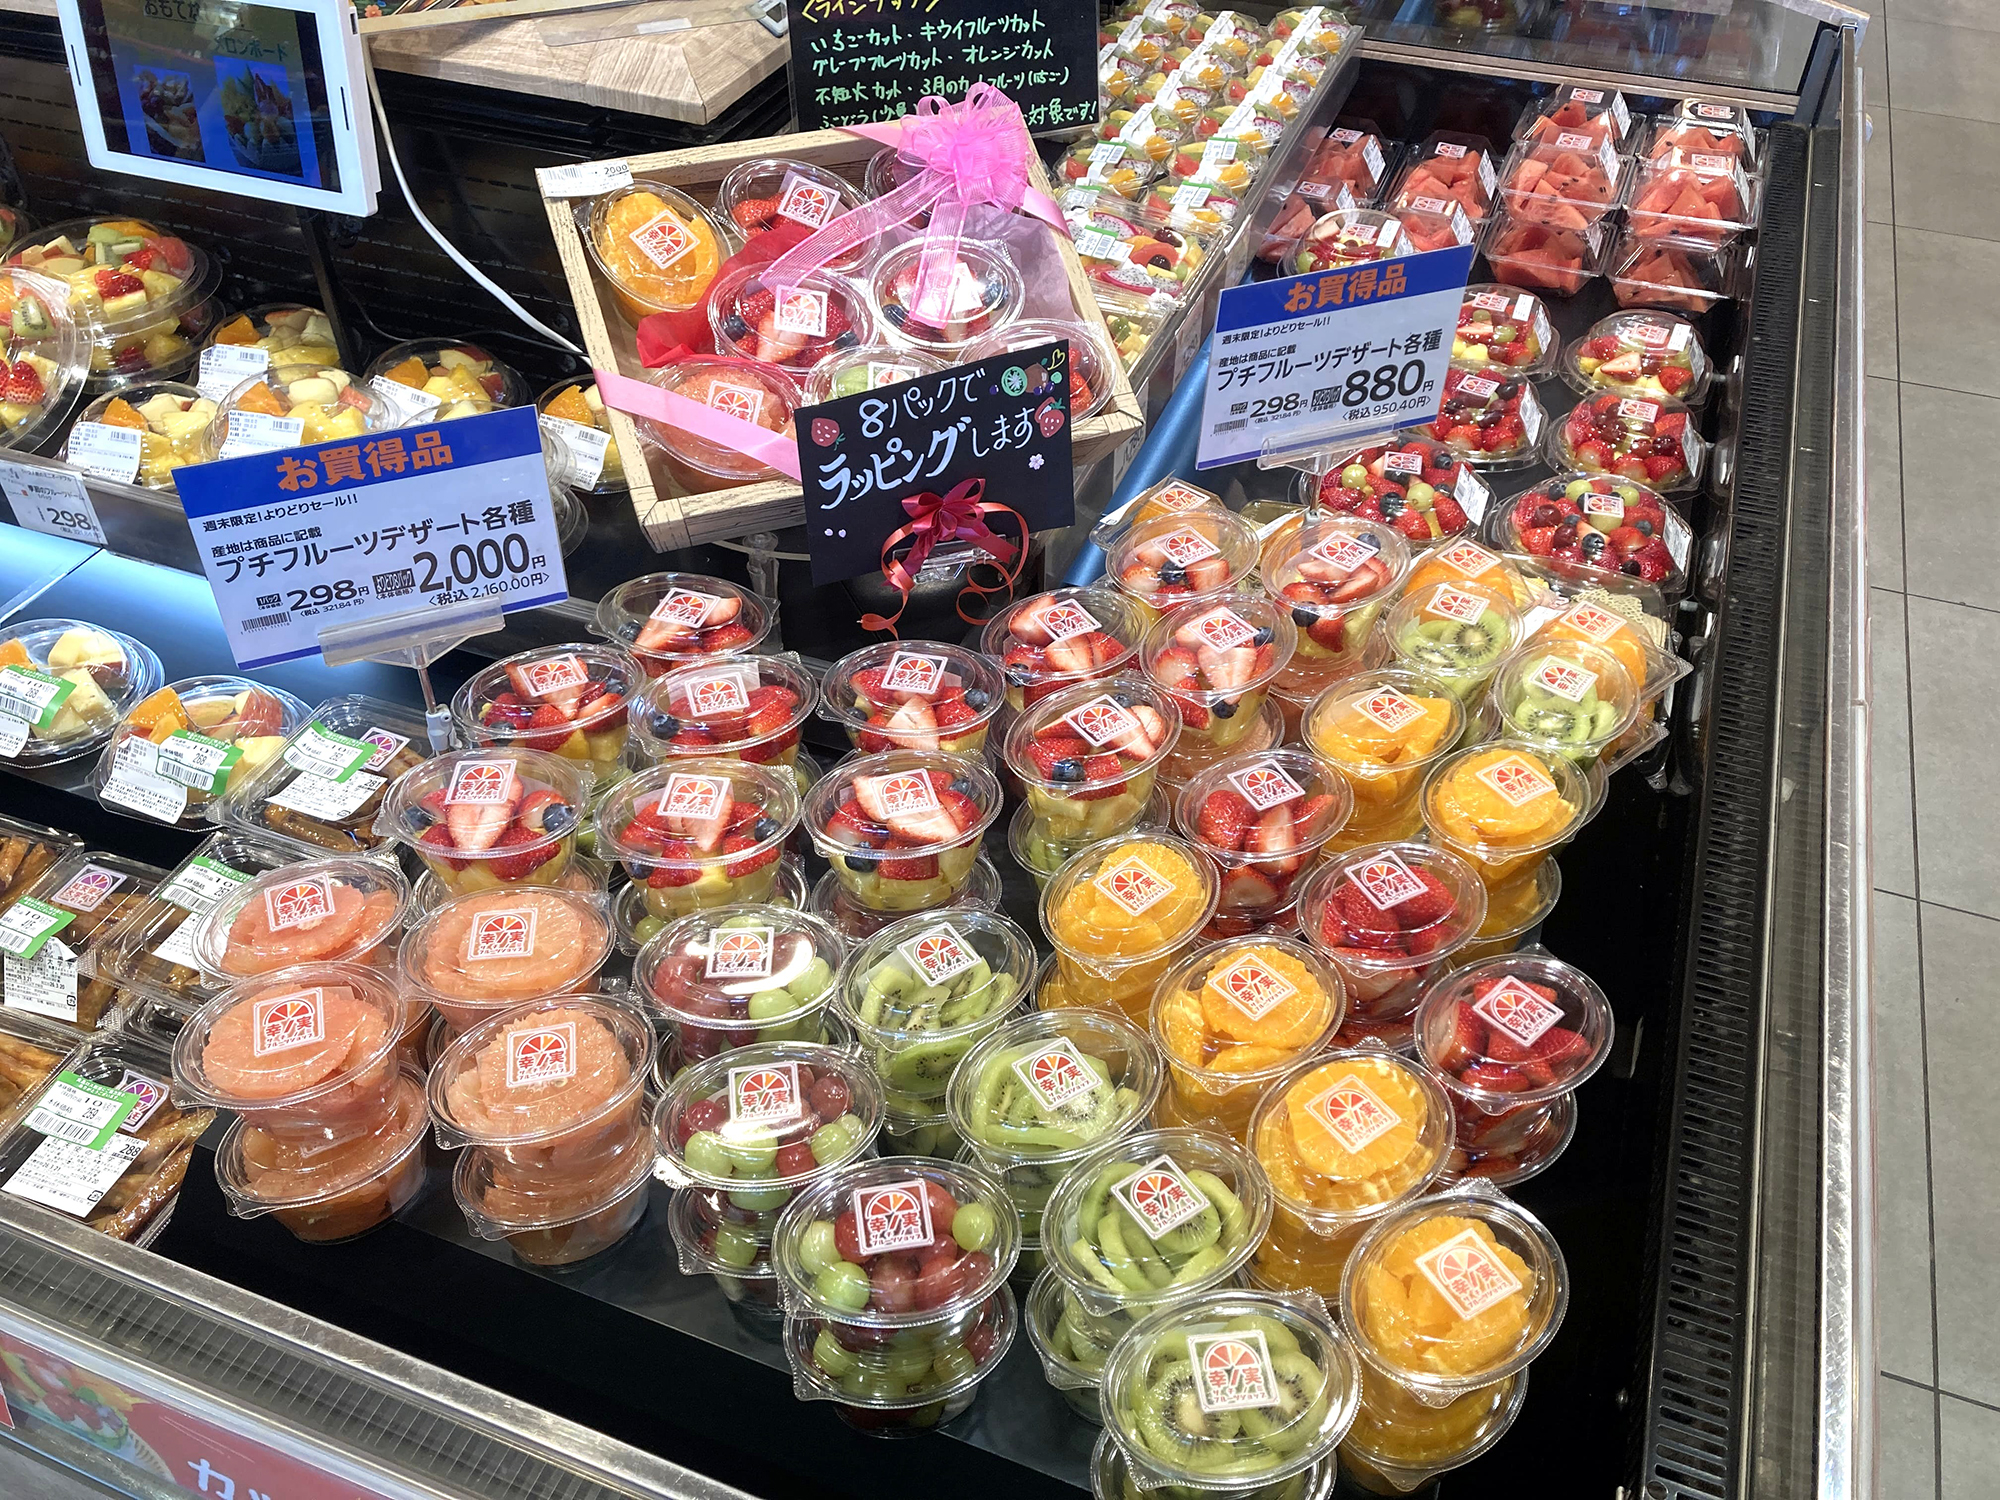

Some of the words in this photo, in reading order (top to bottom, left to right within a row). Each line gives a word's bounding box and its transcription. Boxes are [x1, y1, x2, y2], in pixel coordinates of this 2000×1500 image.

[645, 228, 676, 256] 幸ノ実
[1284, 263, 1407, 313] お買得品
[1217, 328, 1443, 391] プチフルーツデザート各種
[1218, 344, 1297, 368] 産地は商品に記載
[859, 367, 986, 439] 8パックで
[276, 430, 453, 492] お買得品
[211, 525, 323, 558] 産地は商品に記載
[216, 499, 536, 584] プチフルーツデザート各種
[894, 669, 932, 682] 幸ノ実
[698, 690, 736, 704] 幸ノ実
[1086, 712, 1123, 734] 幸ノ実
[458, 780, 501, 791] 幸ノ実
[884, 788, 925, 805] 幸ノ実
[1249, 778, 1287, 797] 幸ノ実
[671, 793, 713, 806] 幸ノ実
[1122, 876, 1156, 901] 幸ノ実
[1369, 872, 1409, 895] 幸ノ実
[278, 894, 322, 916] 幸ノ実
[480, 930, 524, 945] 幸ノ実
[719, 950, 761, 963] 幸ノ実
[921, 944, 963, 971] 幸ノ実
[1237, 974, 1277, 1004] 幸ノ実
[266, 1014, 312, 1038] 幸ノ実
[1504, 999, 1541, 1030] 幸ノ実
[519, 1049, 563, 1070] 幸ノ実
[1037, 1063, 1083, 1093] 幸ノ実
[742, 1088, 787, 1108] 幸ノ実
[1335, 1100, 1379, 1134] 幸ノ実
[120, 1144, 141, 1156] 288
[1140, 1183, 1188, 1219] 幸ノ実
[869, 1211, 918, 1233] 幸ノ実
[1449, 1261, 1497, 1297] 幸ノ実
[1207, 1366, 1261, 1388] 幸ノ実
